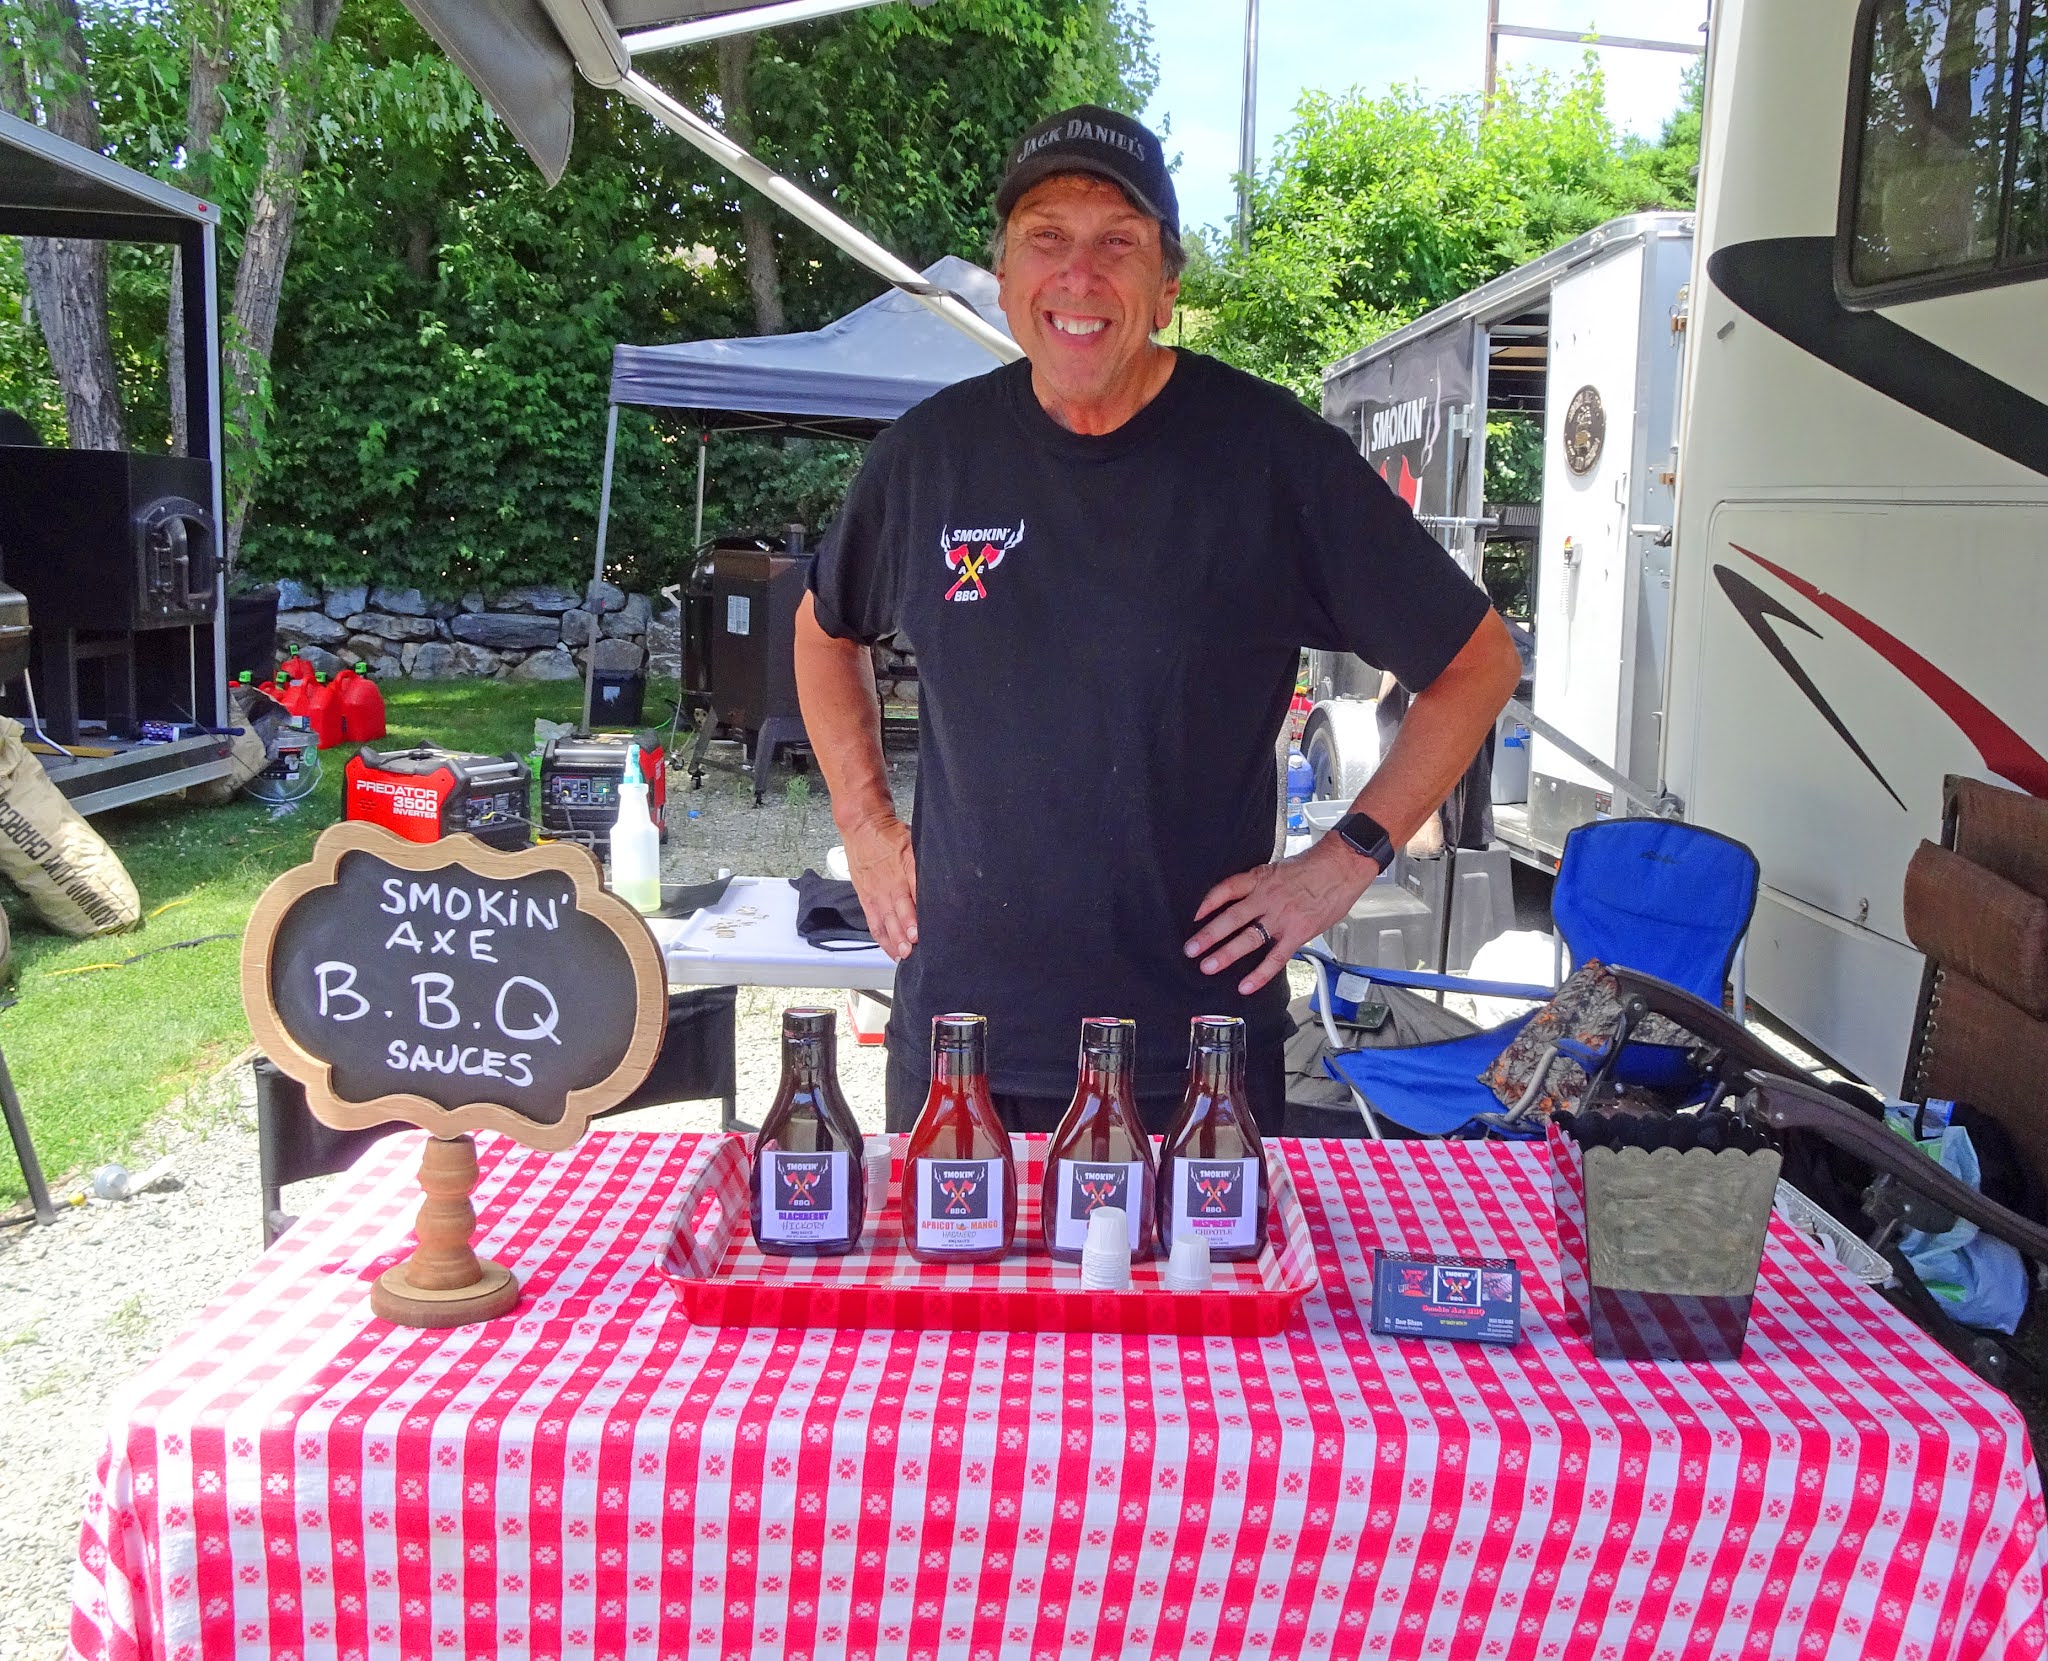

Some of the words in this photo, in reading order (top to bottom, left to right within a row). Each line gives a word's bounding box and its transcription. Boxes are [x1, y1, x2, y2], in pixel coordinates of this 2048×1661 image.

[1017, 126, 1062, 164] JACK
[1066, 119, 1145, 162] DANIEL'S
[1371, 396, 1427, 452] SMOKIN'
[952, 528, 1011, 542] SMOKIN'
[954, 590, 979, 602] BBQ
[356, 780, 438, 801] PREDATOR
[393, 795, 438, 812] 3500
[393, 807, 438, 820] INVERTER
[0, 798, 52, 861] CHARCO
[385, 921, 498, 963] AXE
[386, 1040, 534, 1087] SAUCES
[781, 1220, 825, 1231] HICKORY
[921, 1220, 955, 1230] APRICOT
[970, 1220, 998, 1229] MANGO
